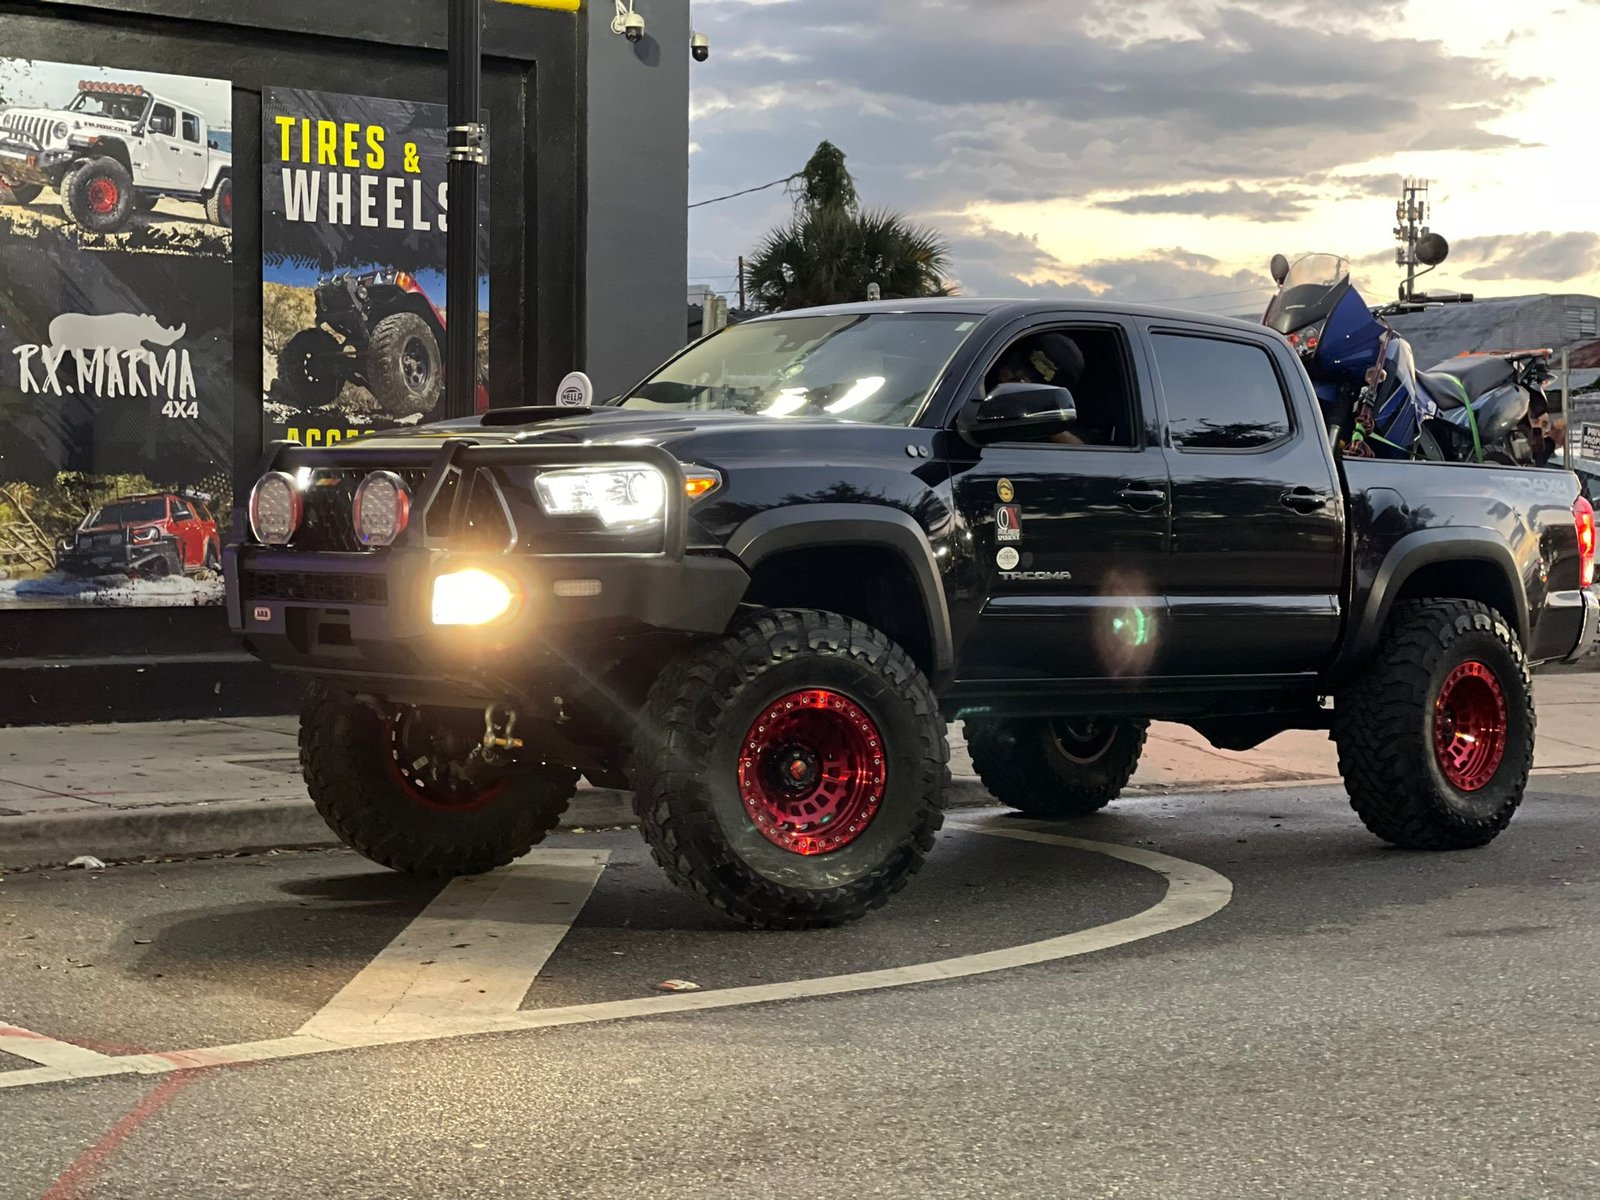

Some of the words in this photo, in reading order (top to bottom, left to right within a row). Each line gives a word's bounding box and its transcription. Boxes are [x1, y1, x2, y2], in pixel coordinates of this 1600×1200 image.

[275, 115, 385, 170] TIRES
[403, 142, 421, 173] &
[562, 392, 583, 402] HELLA
[161, 401, 199, 419] 4X4
[998, 571, 1072, 580] TACOMA
